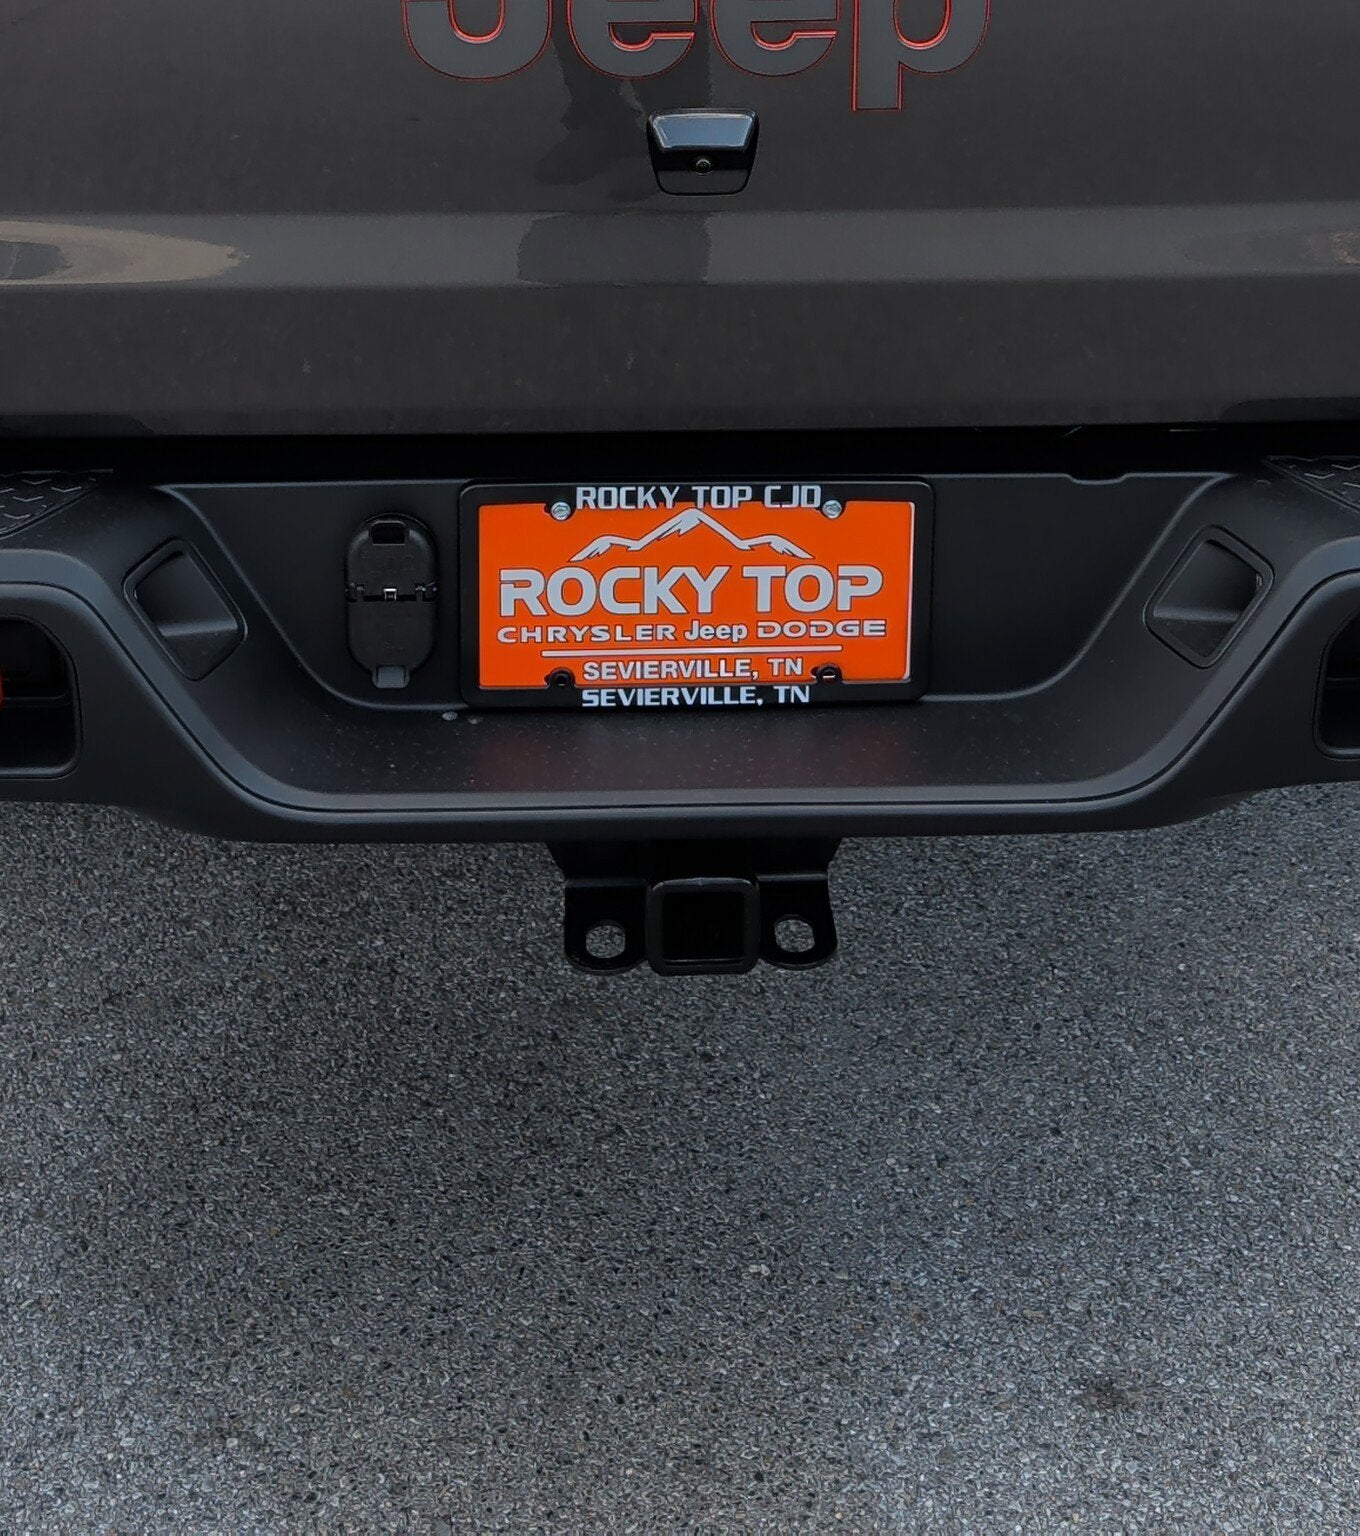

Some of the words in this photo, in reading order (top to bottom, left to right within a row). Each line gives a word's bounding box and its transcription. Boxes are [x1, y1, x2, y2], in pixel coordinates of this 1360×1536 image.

[575, 485, 680, 510] ROCKY
[691, 485, 752, 509] TOP
[764, 485, 821, 508] CJD
[498, 564, 732, 617] ROCKY
[742, 564, 884, 615] TOP
[496, 624, 677, 644] CHRYSLER
[684, 620, 748, 644] Jeep
[757, 620, 888, 639] DODGE
[582, 658, 759, 681] SEVIERVILLE,
[767, 657, 803, 677] TN
[581, 686, 764, 707] SEVIERVILLE,
[774, 685, 811, 704] TN
